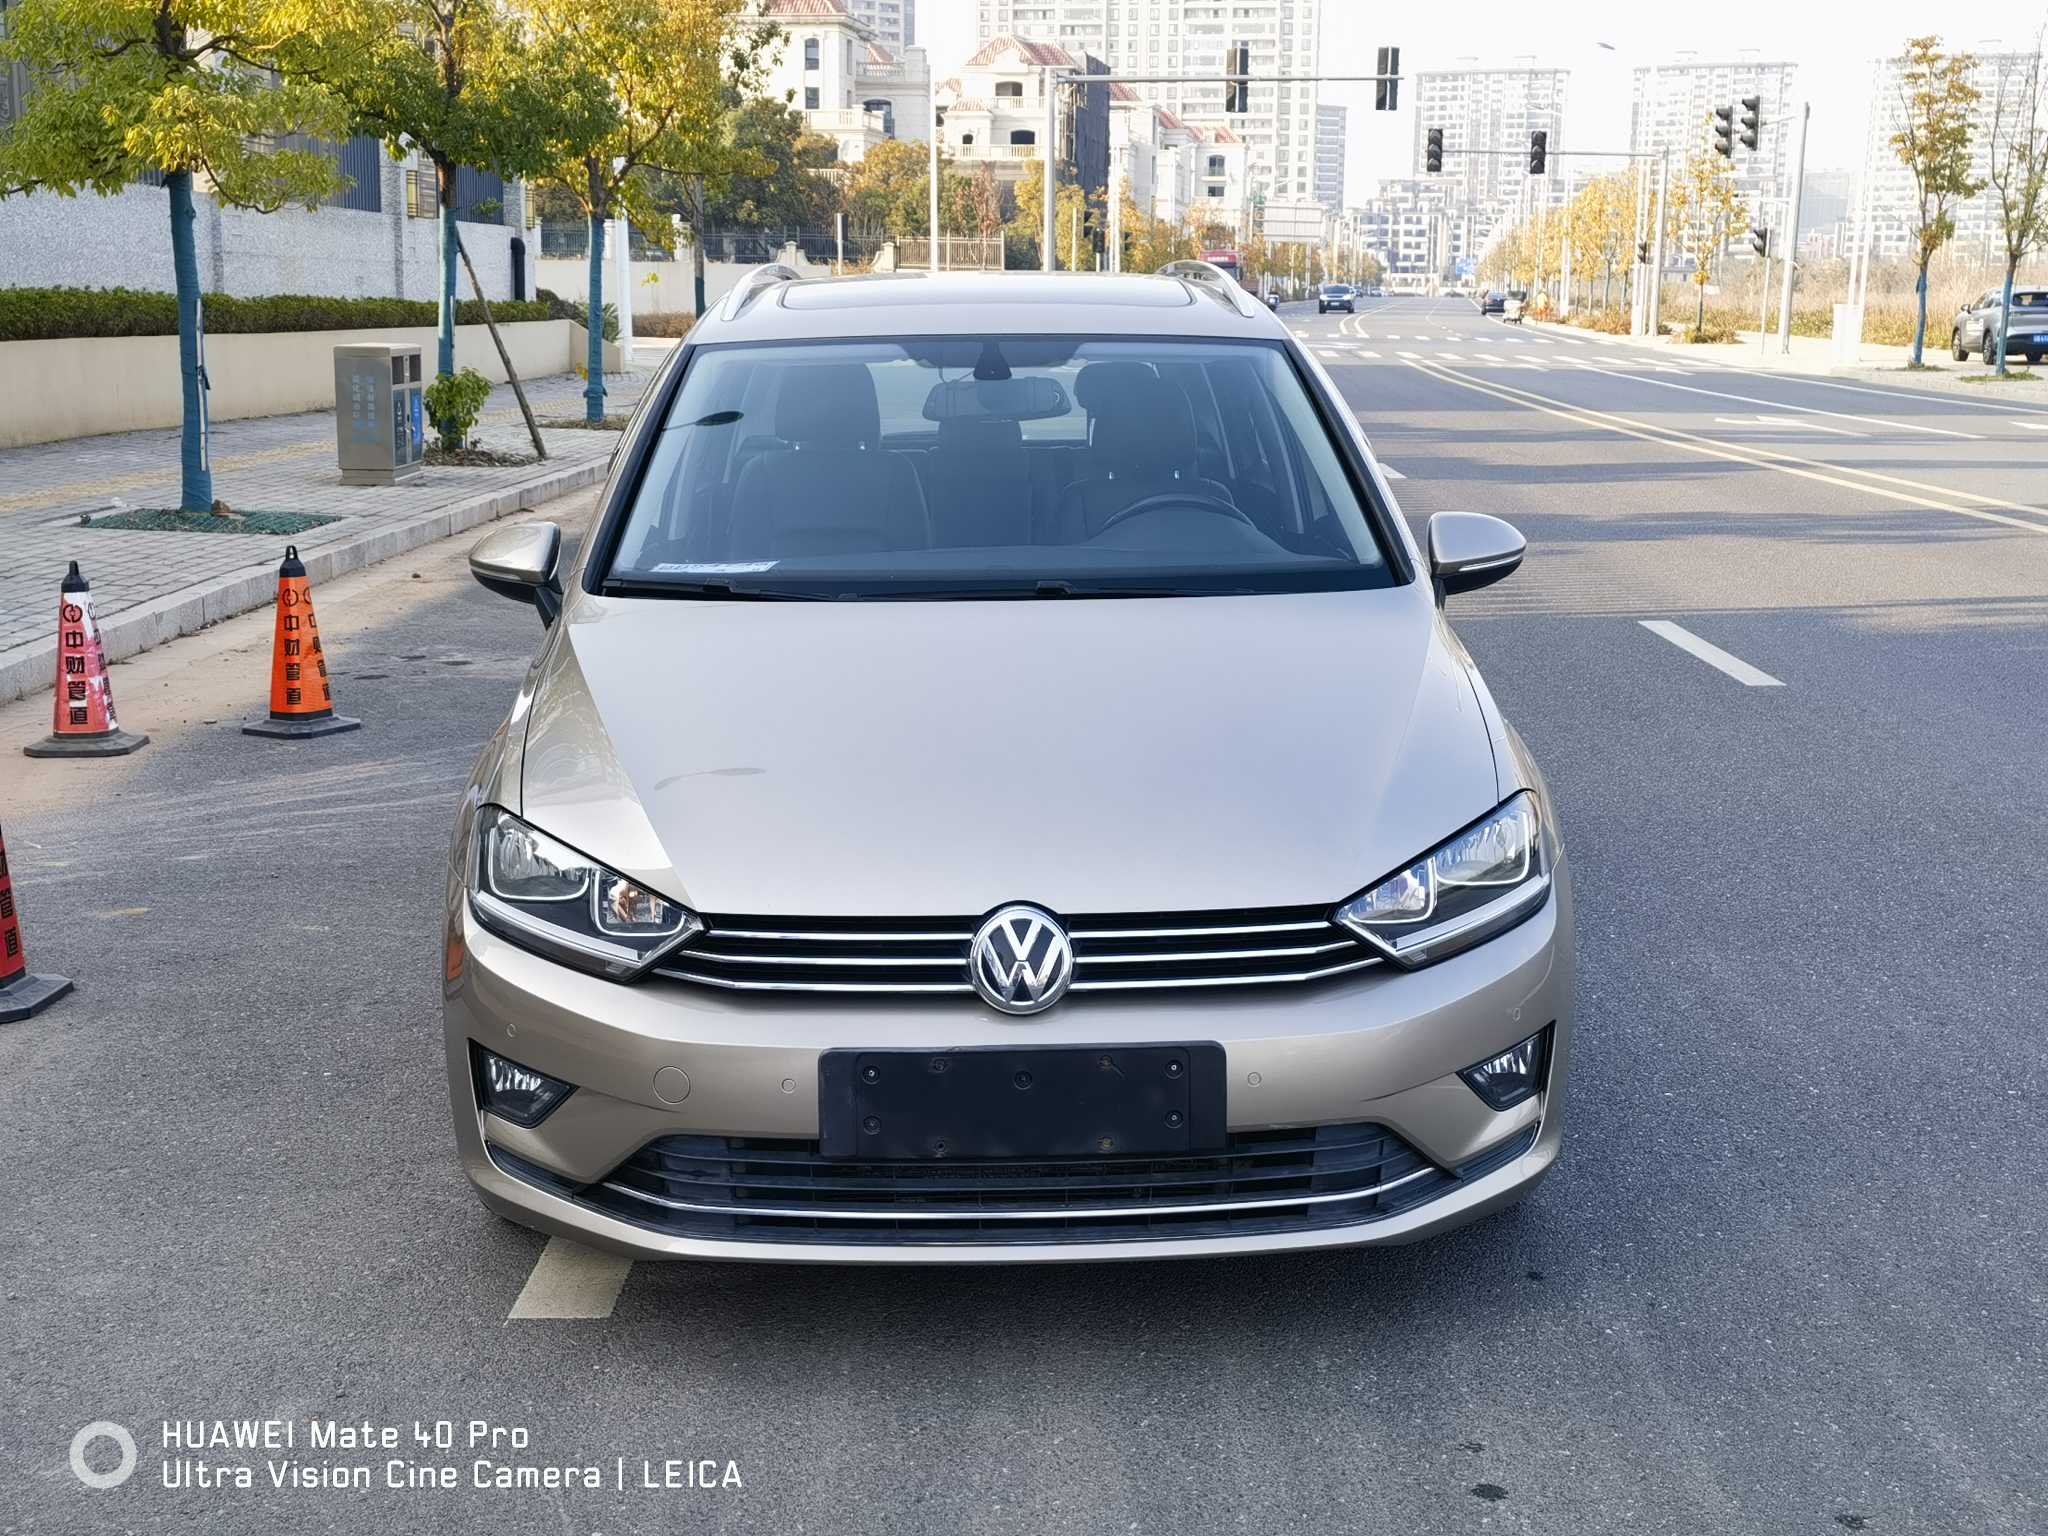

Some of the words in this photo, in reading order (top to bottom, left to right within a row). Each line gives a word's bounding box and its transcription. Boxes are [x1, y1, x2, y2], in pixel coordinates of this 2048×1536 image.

[65, 629, 89, 726] 中财管道
[283, 614, 302, 705] 中财管道
